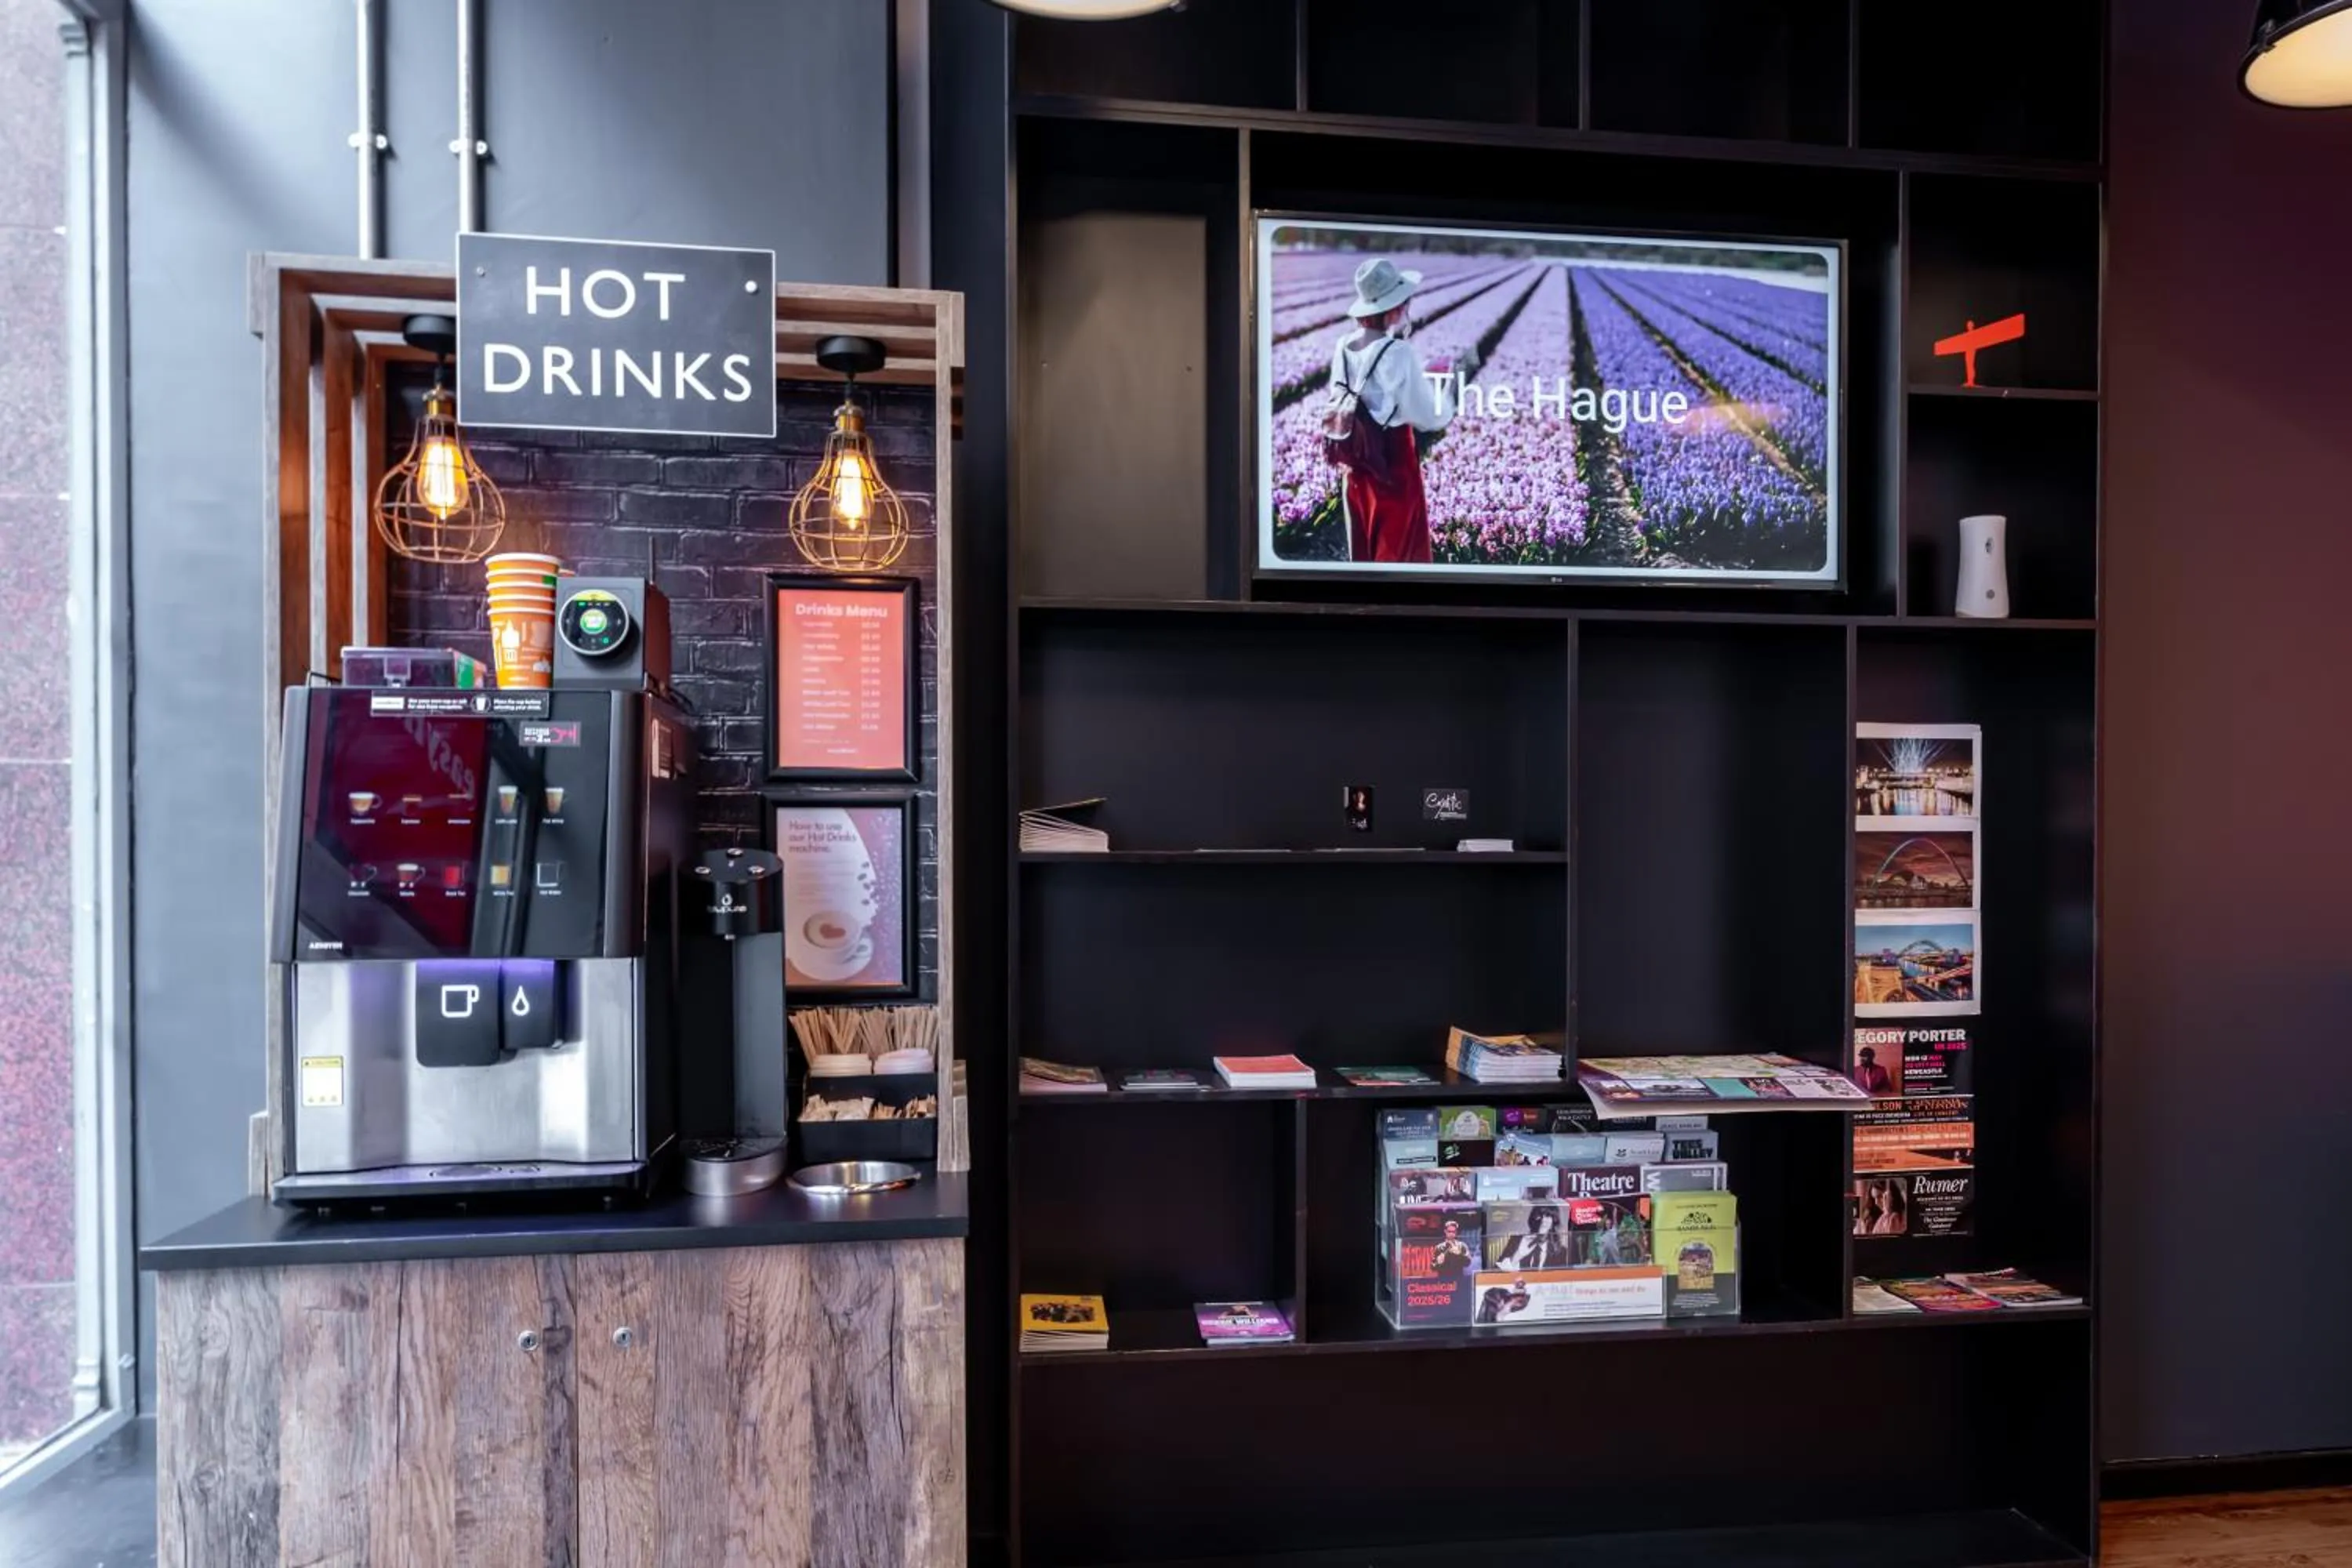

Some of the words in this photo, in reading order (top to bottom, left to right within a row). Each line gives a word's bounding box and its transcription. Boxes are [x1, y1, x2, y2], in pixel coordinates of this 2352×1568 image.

[527, 266, 685, 320] HOT
[484, 343, 752, 402] DRINKS
[1423, 372, 1515, 419] The
[1533, 376, 1688, 434] Hague
[795, 603, 842, 616] Drinks
[846, 604, 887, 618] Menu
[827, 833, 857, 842] Drinks
[1909, 1029, 1966, 1043] PORTER
[1568, 1171, 1635, 1192] Theatre
[1912, 1175, 1969, 1194] Rumer
[1407, 1281, 1457, 1293] Classical
